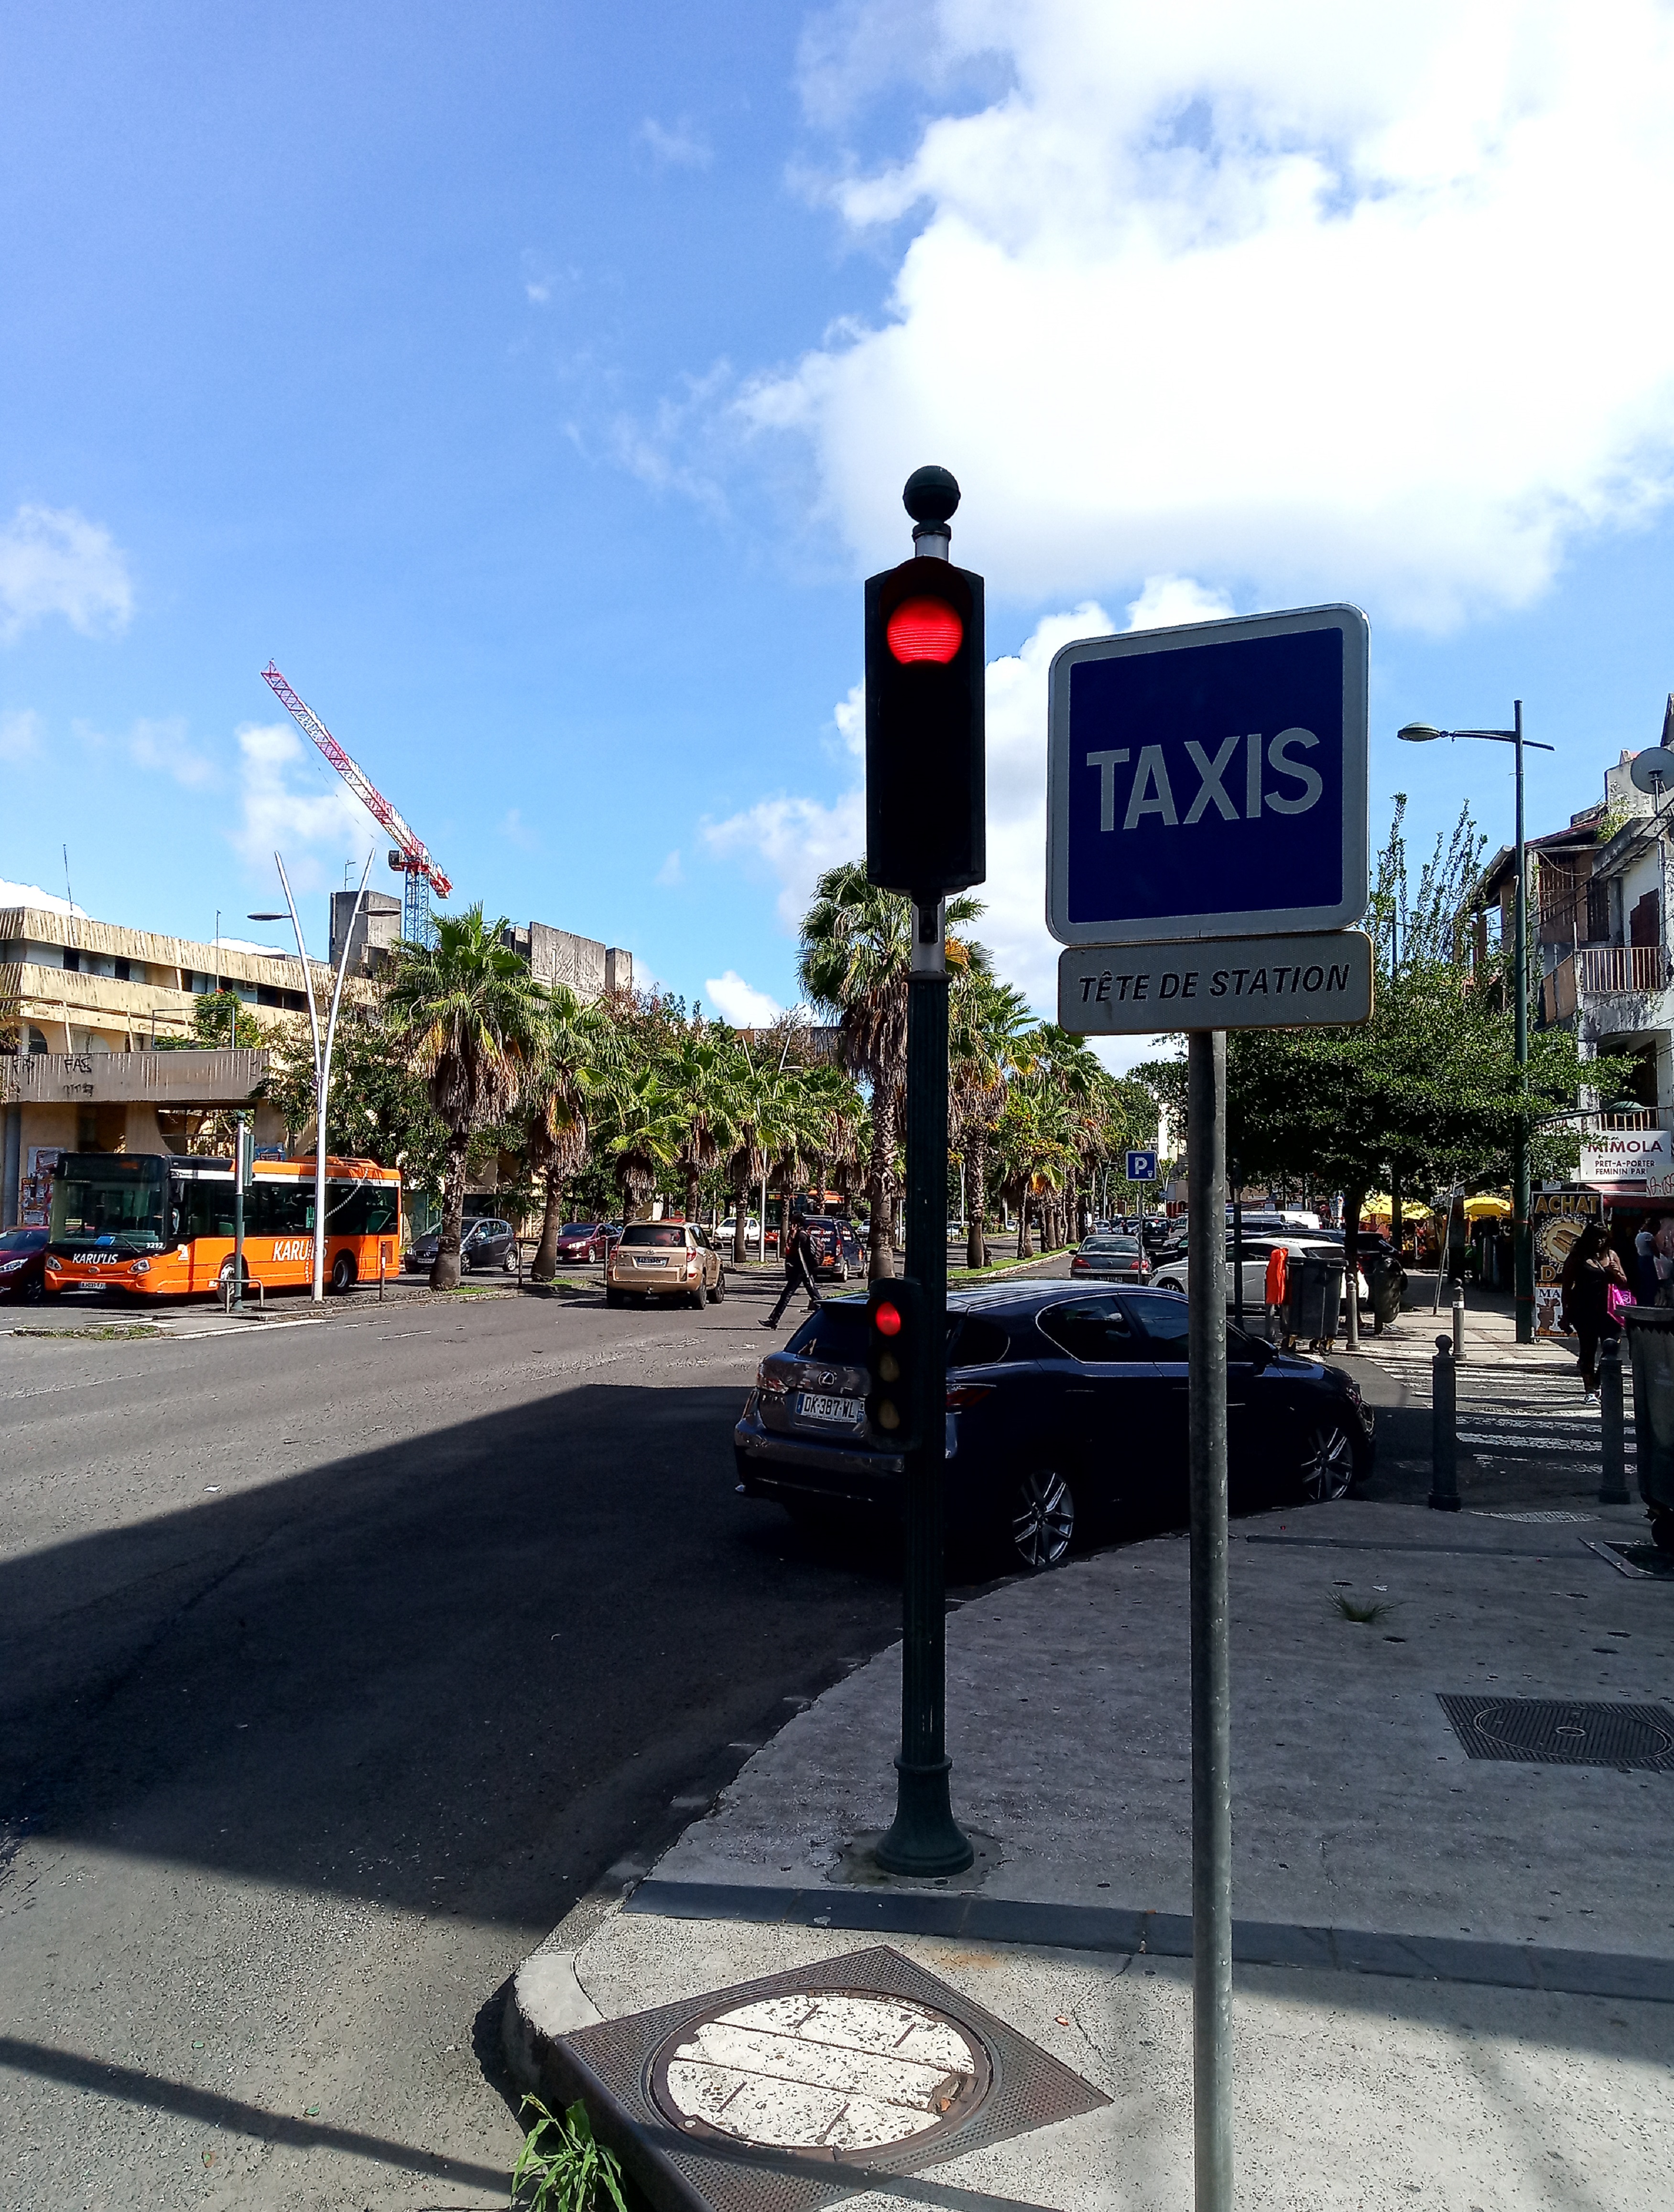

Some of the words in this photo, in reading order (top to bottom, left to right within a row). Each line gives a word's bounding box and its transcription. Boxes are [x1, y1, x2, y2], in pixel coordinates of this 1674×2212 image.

[1087, 727, 1323, 832] TAXIS
[1079, 969, 1150, 1003] TÊTE
[1158, 971, 1200, 1000] DE
[1208, 963, 1350, 998] STATION
[1587, 1140, 1663, 1153] MIMOLA
[1135, 1157, 1147, 1174] P
[1534, 1196, 1599, 1214] ACHAT
[72, 1253, 119, 1265] KARU'LIS
